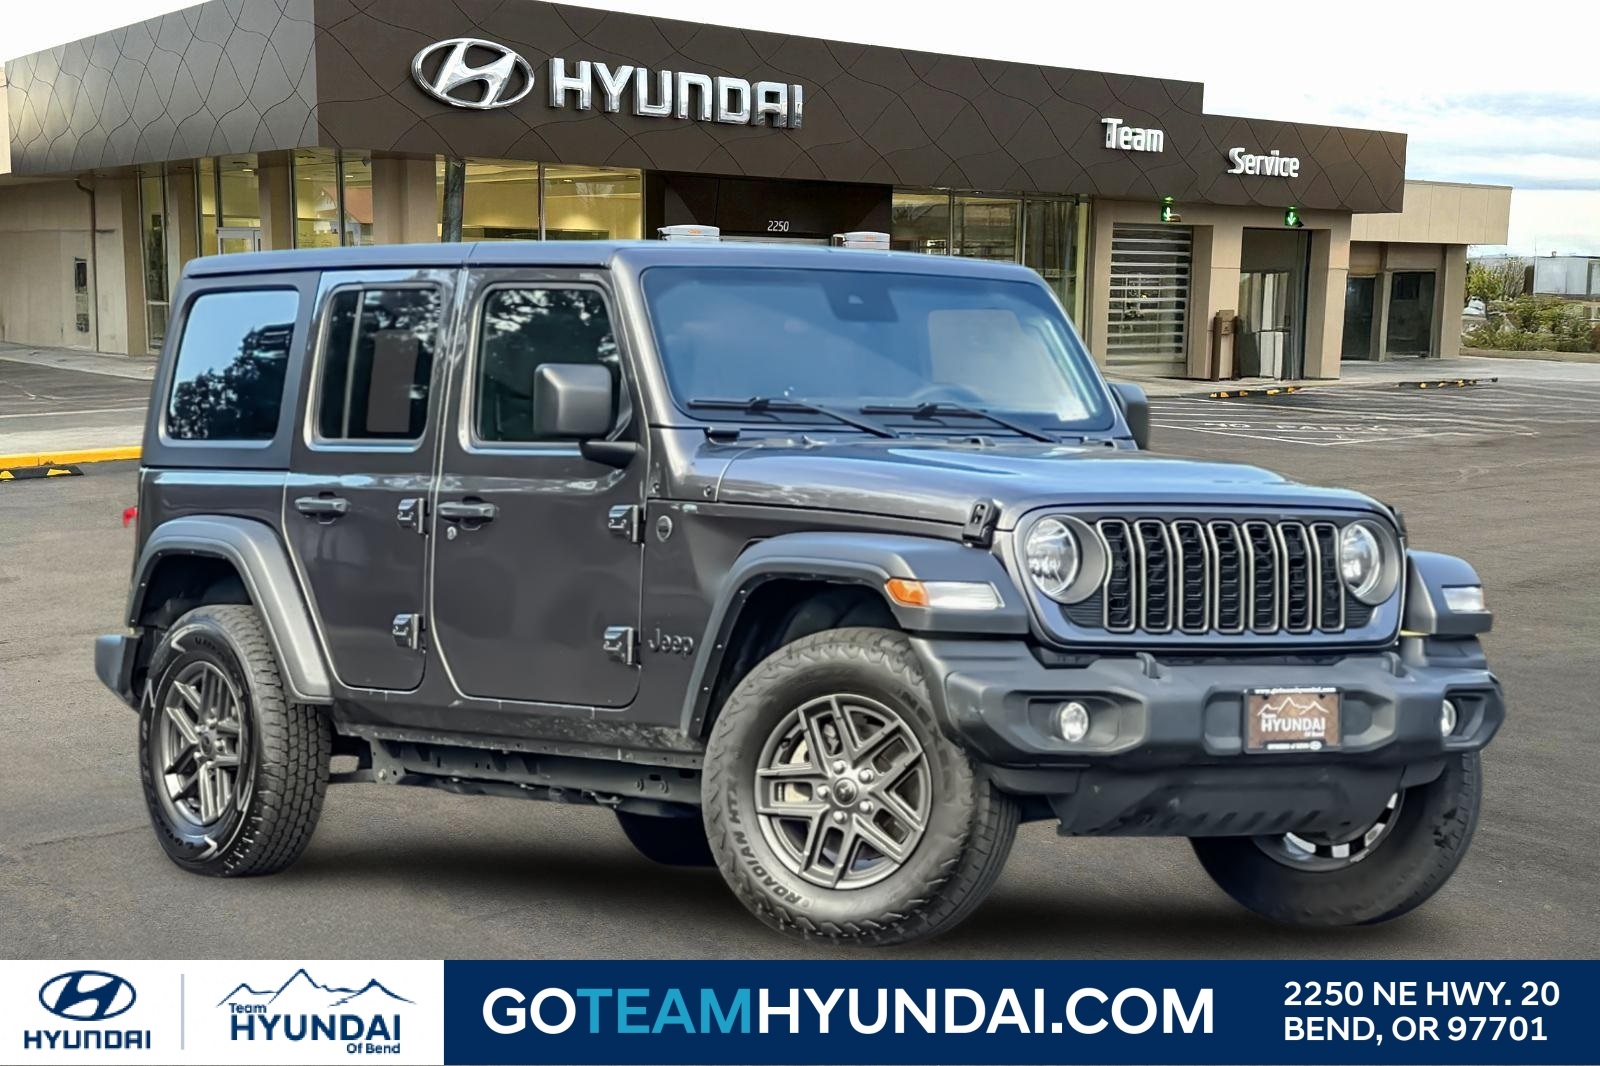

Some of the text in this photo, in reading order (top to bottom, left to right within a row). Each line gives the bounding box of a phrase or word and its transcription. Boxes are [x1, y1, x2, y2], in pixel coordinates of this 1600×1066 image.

[549, 57, 803, 128] HYUNDAI
[1101, 117, 1164, 152] Team
[1228, 147, 1300, 178] Service
[767, 220, 790, 232] 2250
[648, 628, 694, 656] Jeep
[1261, 716, 1326, 732] HYUNDAI
[733, 831, 802, 905] ROADIAN
